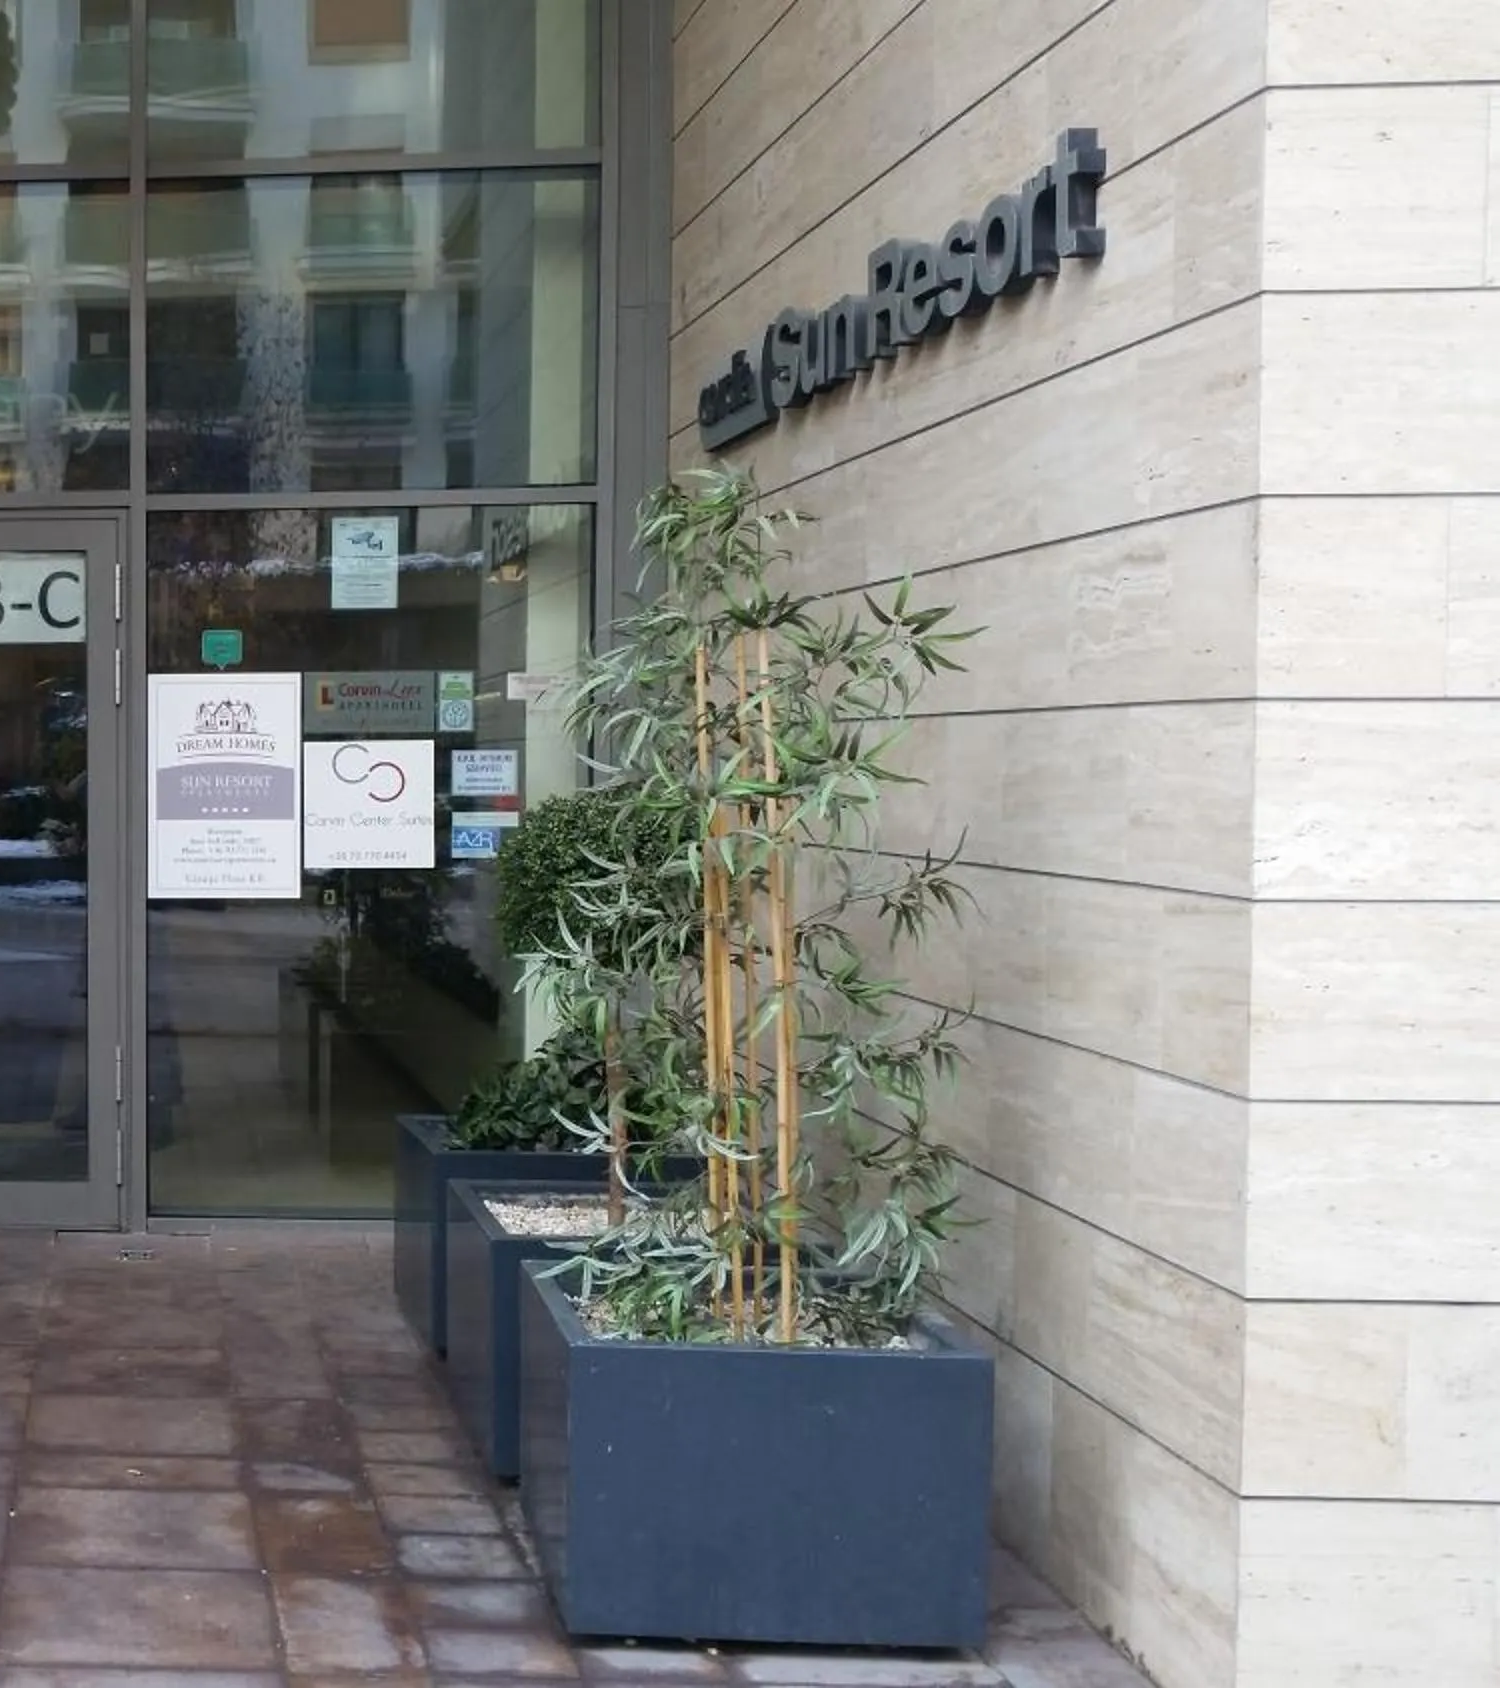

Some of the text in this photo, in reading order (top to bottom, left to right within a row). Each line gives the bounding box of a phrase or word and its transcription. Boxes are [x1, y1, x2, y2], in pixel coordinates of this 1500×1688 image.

[338, 683, 381, 698] Corvin
[177, 737, 276, 753] DREAM HOMES
[180, 775, 273, 788] SUN RESORT
[350, 811, 393, 826] Center
